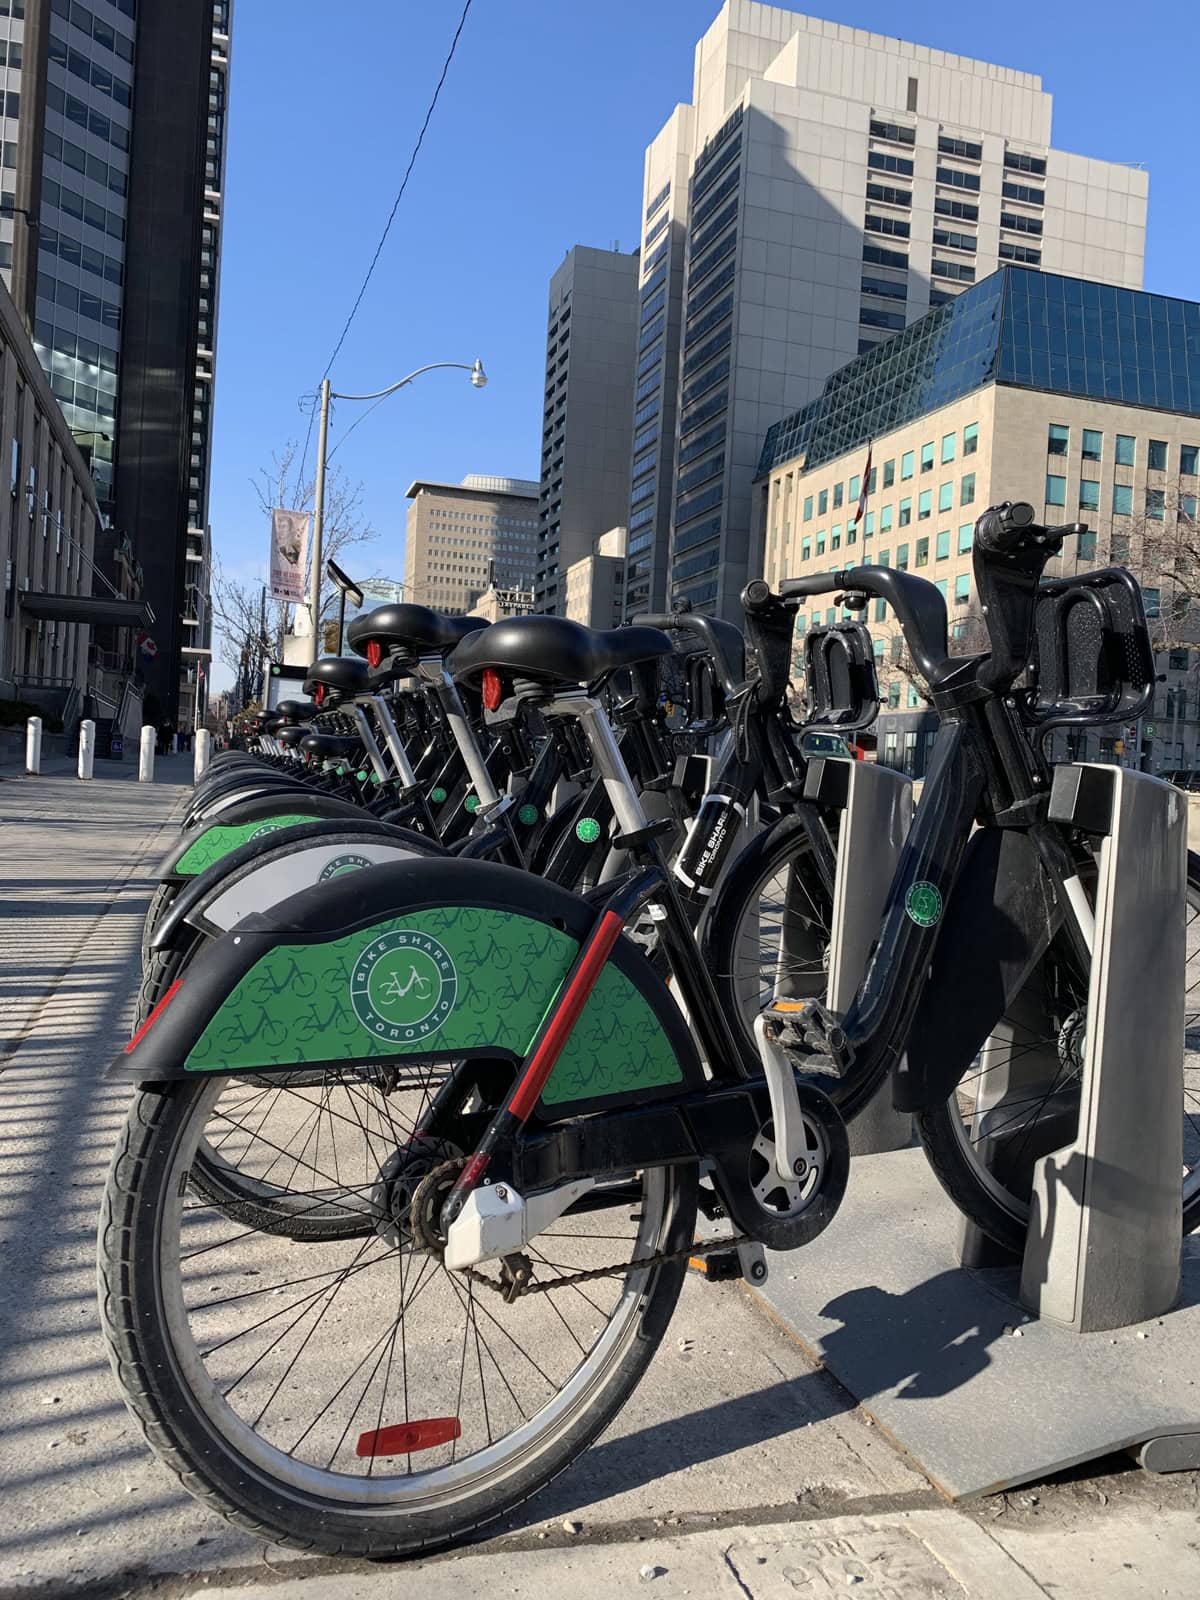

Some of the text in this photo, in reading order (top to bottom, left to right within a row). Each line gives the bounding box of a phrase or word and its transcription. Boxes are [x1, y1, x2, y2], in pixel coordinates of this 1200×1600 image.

[695, 811, 728, 876] BIKE SHARE
[708, 828, 727, 864] TORONTO
[357, 935, 449, 981] BIKE SHARE
[365, 1001, 449, 1037] TORONTO
